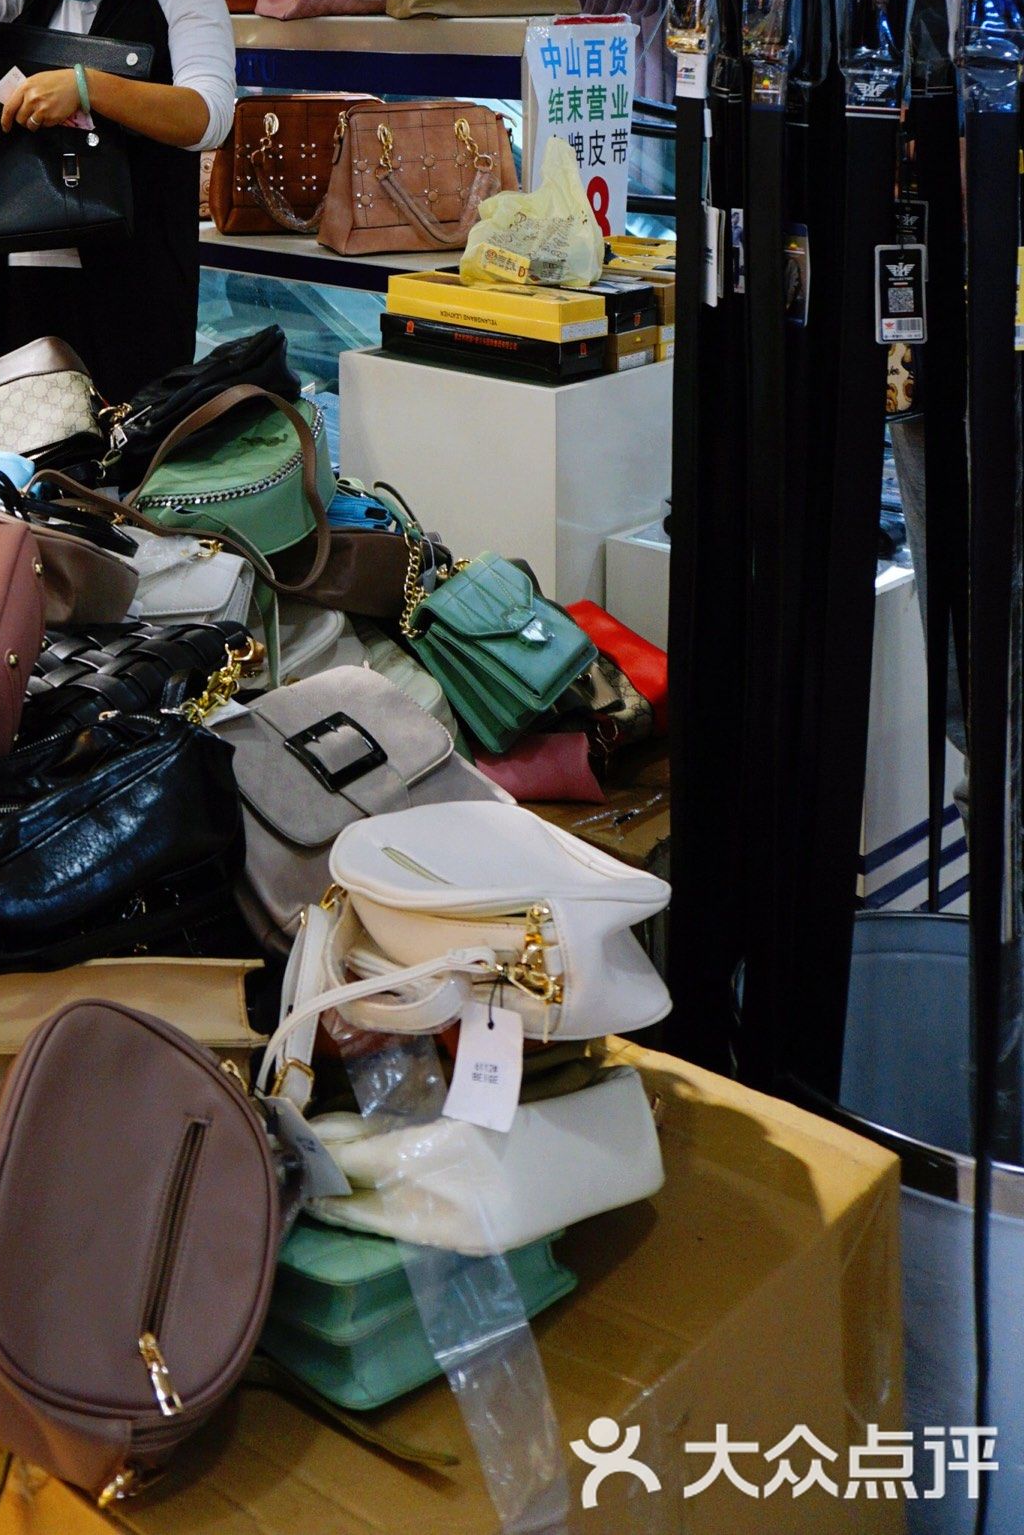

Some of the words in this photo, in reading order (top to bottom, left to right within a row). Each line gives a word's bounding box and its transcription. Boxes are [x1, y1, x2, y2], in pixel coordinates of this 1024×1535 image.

[539, 36, 629, 80] 中山百货
[547, 84, 629, 125] 结束营业
[553, 128, 629, 169] 牌皮带
